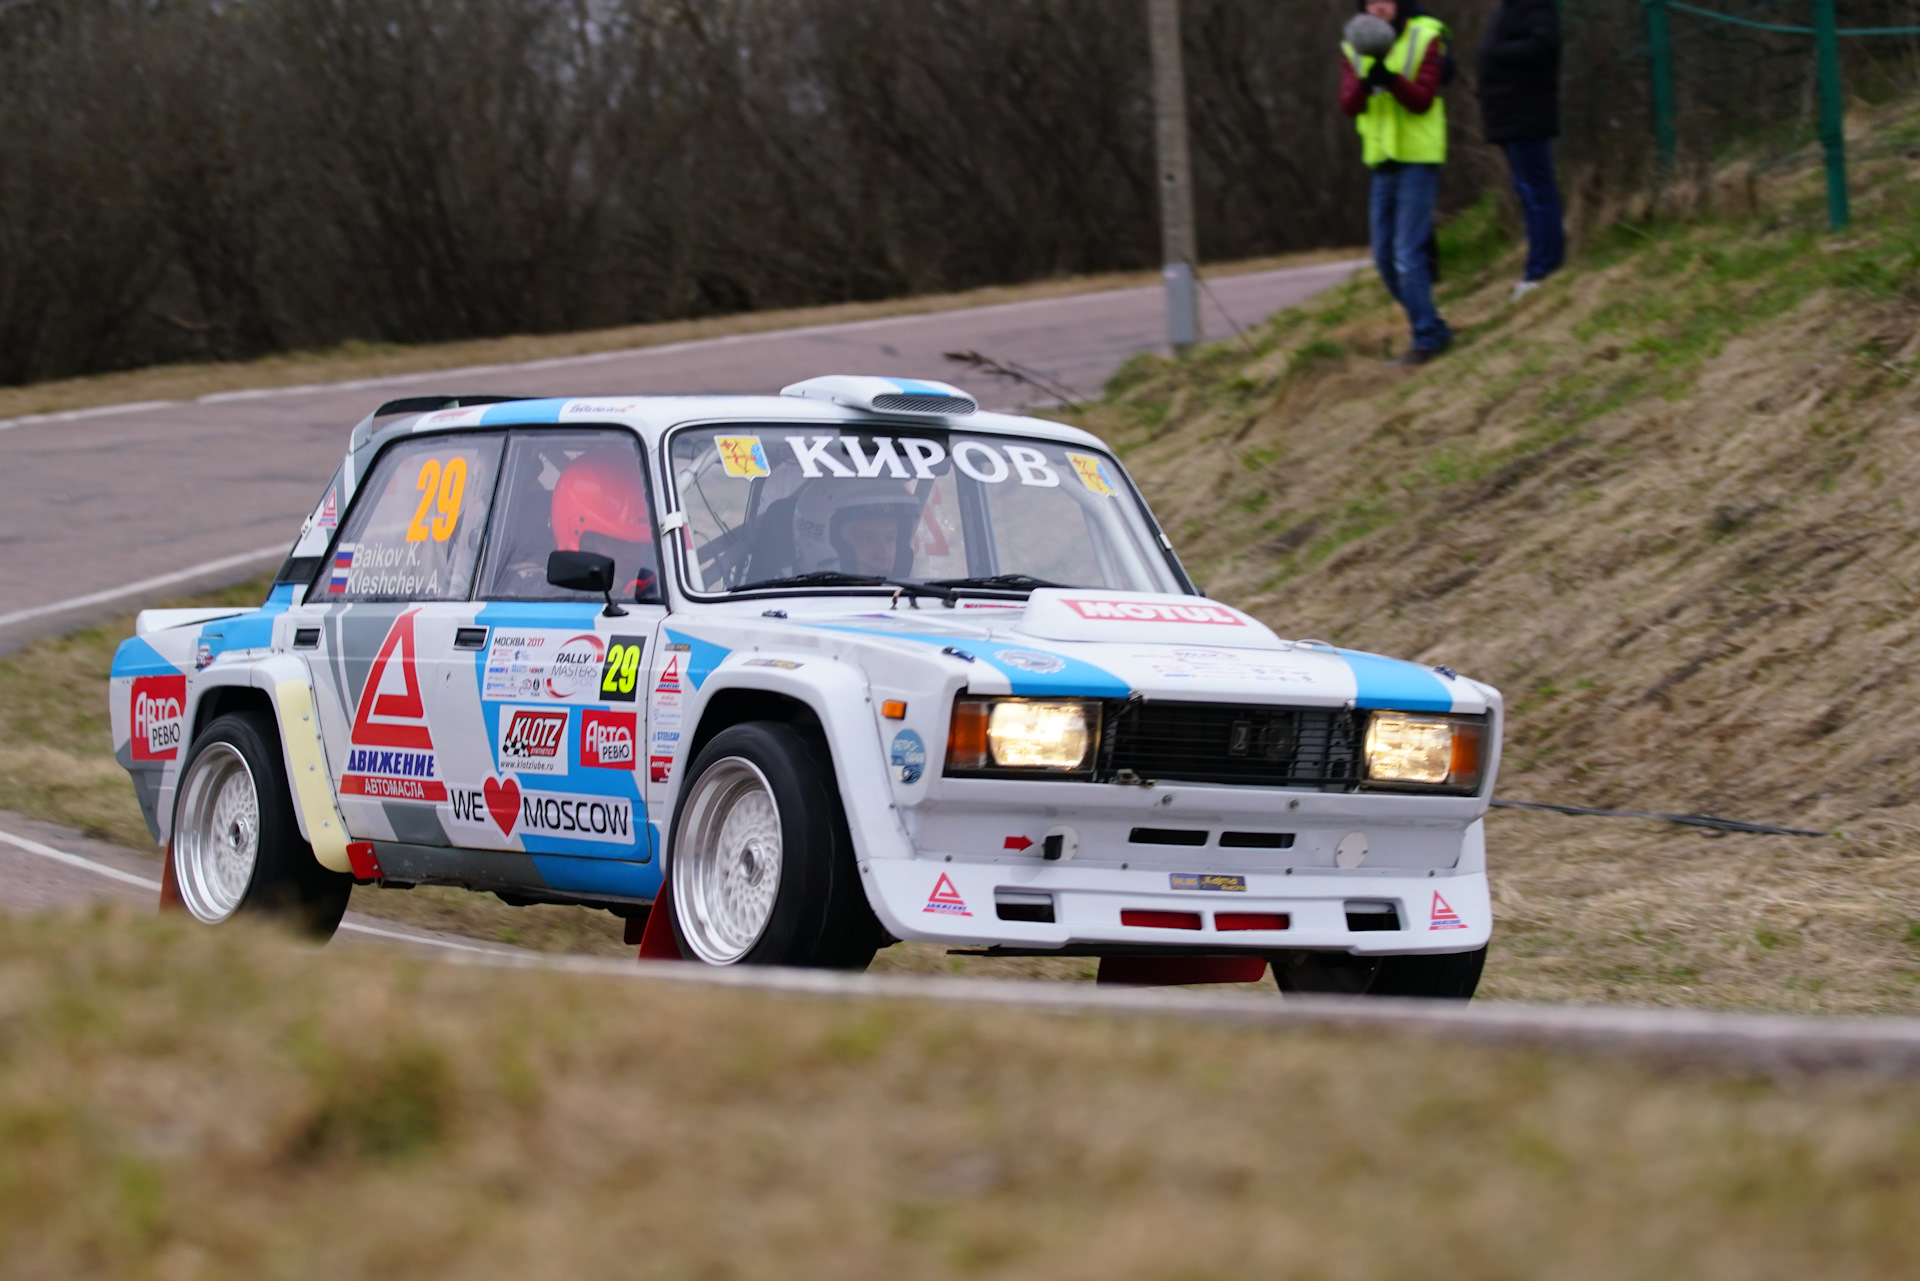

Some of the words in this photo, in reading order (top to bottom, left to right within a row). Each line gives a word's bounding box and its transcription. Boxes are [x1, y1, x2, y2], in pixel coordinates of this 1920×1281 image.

[785, 436, 1060, 488] КИРОВ
[406, 457, 467, 542] 29
[351, 543, 404, 568] Baikov
[406, 542, 421, 566] K.
[345, 568, 424, 595] Kleshchev
[425, 569, 441, 594] A.
[1077, 601, 1236, 623] MOTUL
[494, 637, 525, 647] МОСКВА
[526, 637, 545, 648] 2017
[551, 664, 598, 678] MASTERS
[556, 653, 592, 664] RALLY
[602, 644, 640, 694] 29
[152, 722, 181, 748] РЕВЮ
[510, 716, 563, 748] KLOTZ
[348, 749, 435, 777] ДВИЖЕНИЕ
[500, 760, 554, 771] www.klotzlube.ru
[602, 744, 630, 761] РЕВЮ
[364, 777, 425, 799] АВТОМАСЛА
[451, 789, 485, 823] WE
[523, 796, 629, 836] MOSCOW
